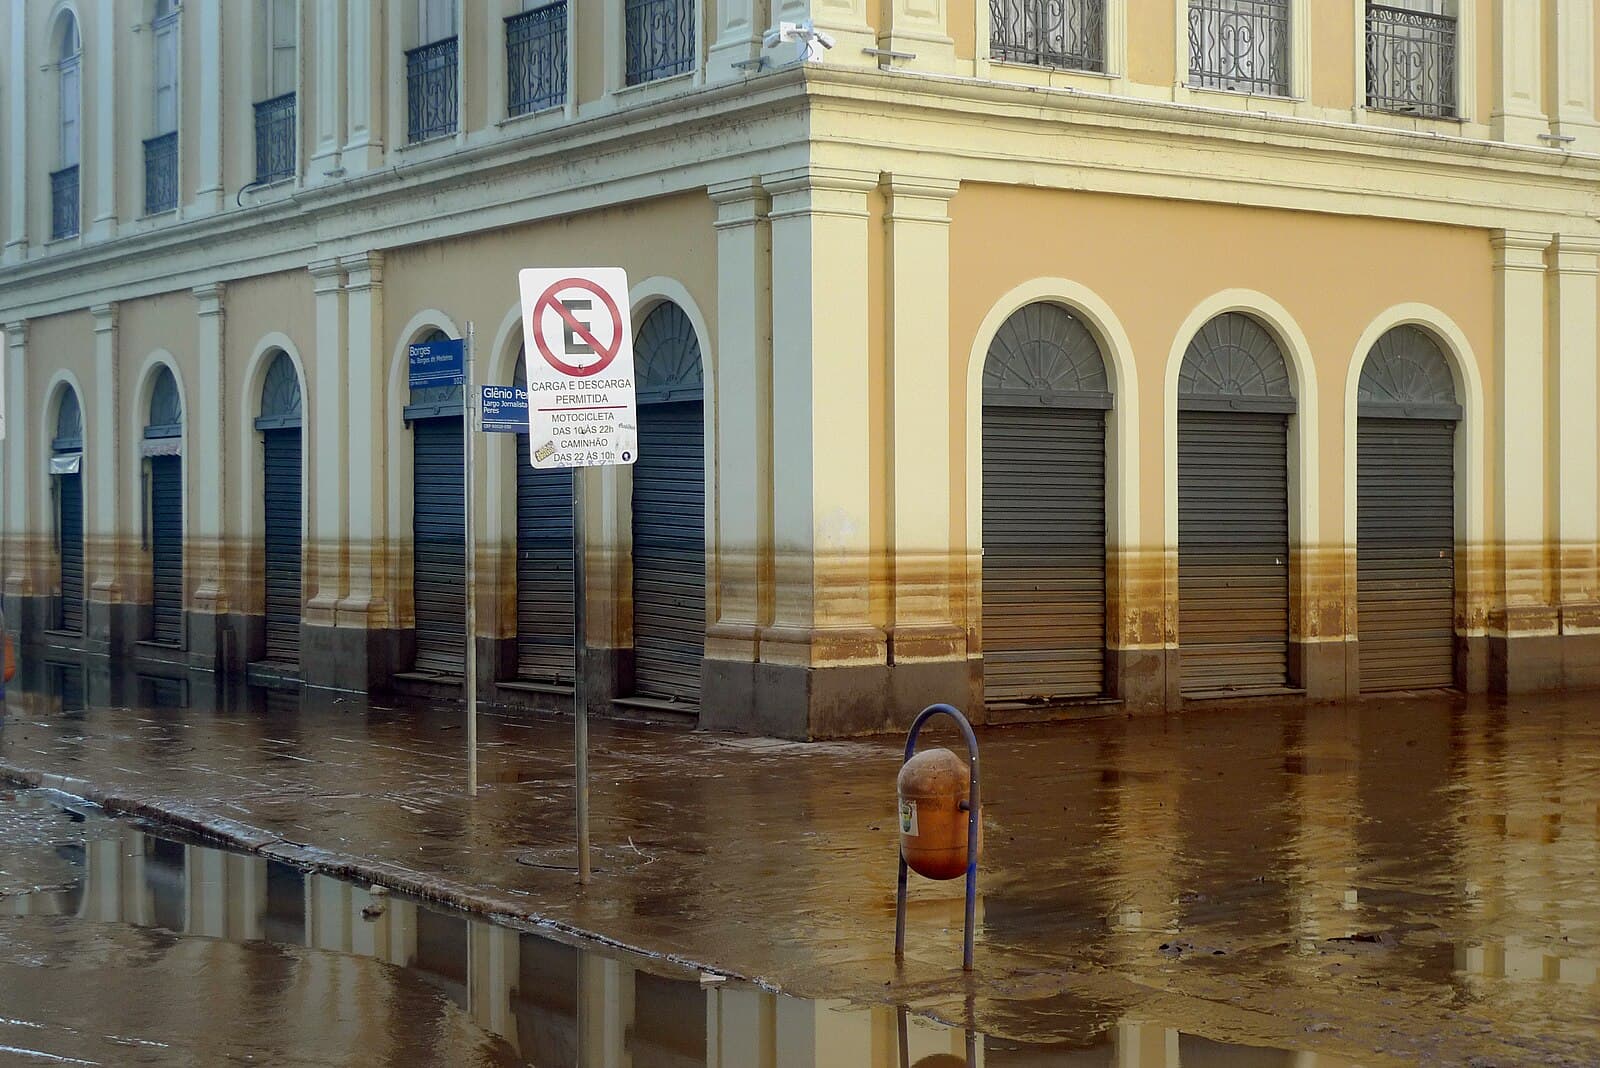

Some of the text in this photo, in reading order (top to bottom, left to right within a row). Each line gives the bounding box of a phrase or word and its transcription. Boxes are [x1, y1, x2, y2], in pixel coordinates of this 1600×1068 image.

[561, 300, 595, 354] E
[410, 346, 430, 358] Borges
[532, 379, 632, 392] CARGA E DESCARGA
[484, 387, 528, 400] Glênio Pe
[556, 394, 608, 404] PERMITIDA
[552, 412, 614, 422] MOTOCICLETA
[552, 427, 571, 436] DAS
[574, 426, 583, 434] 10
[585, 424, 598, 434] ÀS
[600, 426, 614, 434] 22h
[560, 438, 608, 448] CAMINHÃO
[554, 450, 615, 462] DAS 22 ÀS 10h
